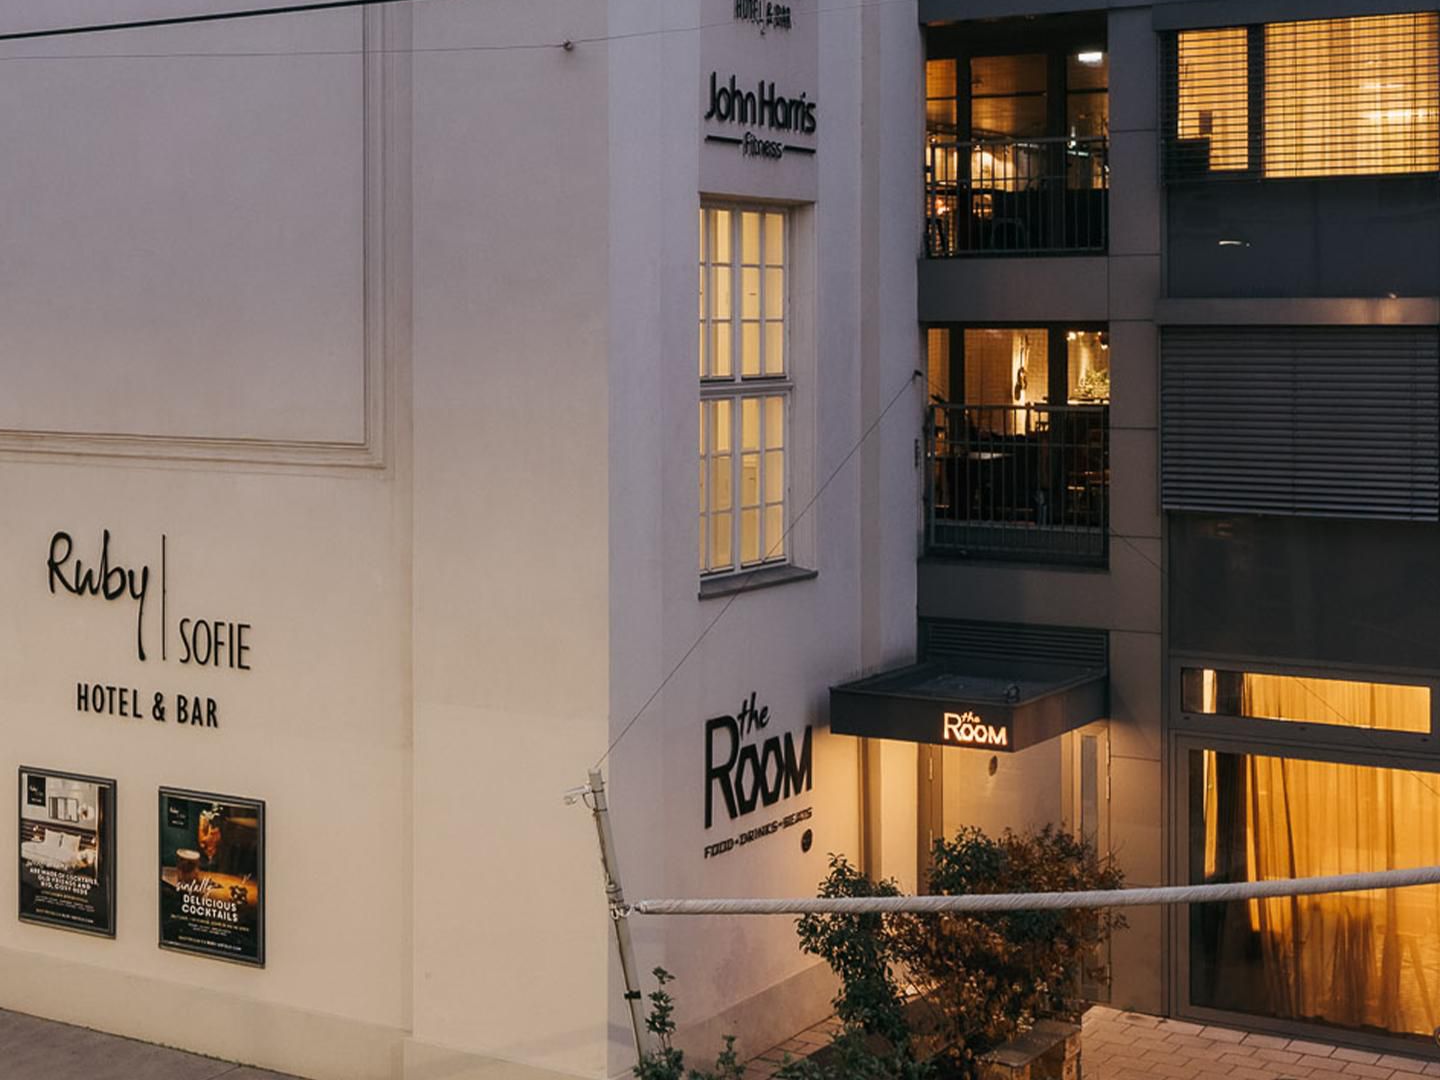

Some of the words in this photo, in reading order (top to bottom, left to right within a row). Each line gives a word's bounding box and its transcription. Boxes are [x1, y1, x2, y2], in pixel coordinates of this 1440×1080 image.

[47, 529, 149, 662] Ruby
[178, 618, 252, 670] SOFIE
[76, 682, 143, 720] HOTEL
[152, 691, 166, 722] &
[176, 694, 219, 729] BAR
[737, 691, 771, 740] the
[943, 712, 1008, 746] ROOM
[961, 710, 980, 724] the
[705, 715, 813, 830] ROOM
[181, 903, 239, 923] COCKTAILS
[183, 893, 237, 912] DELICIOUS
